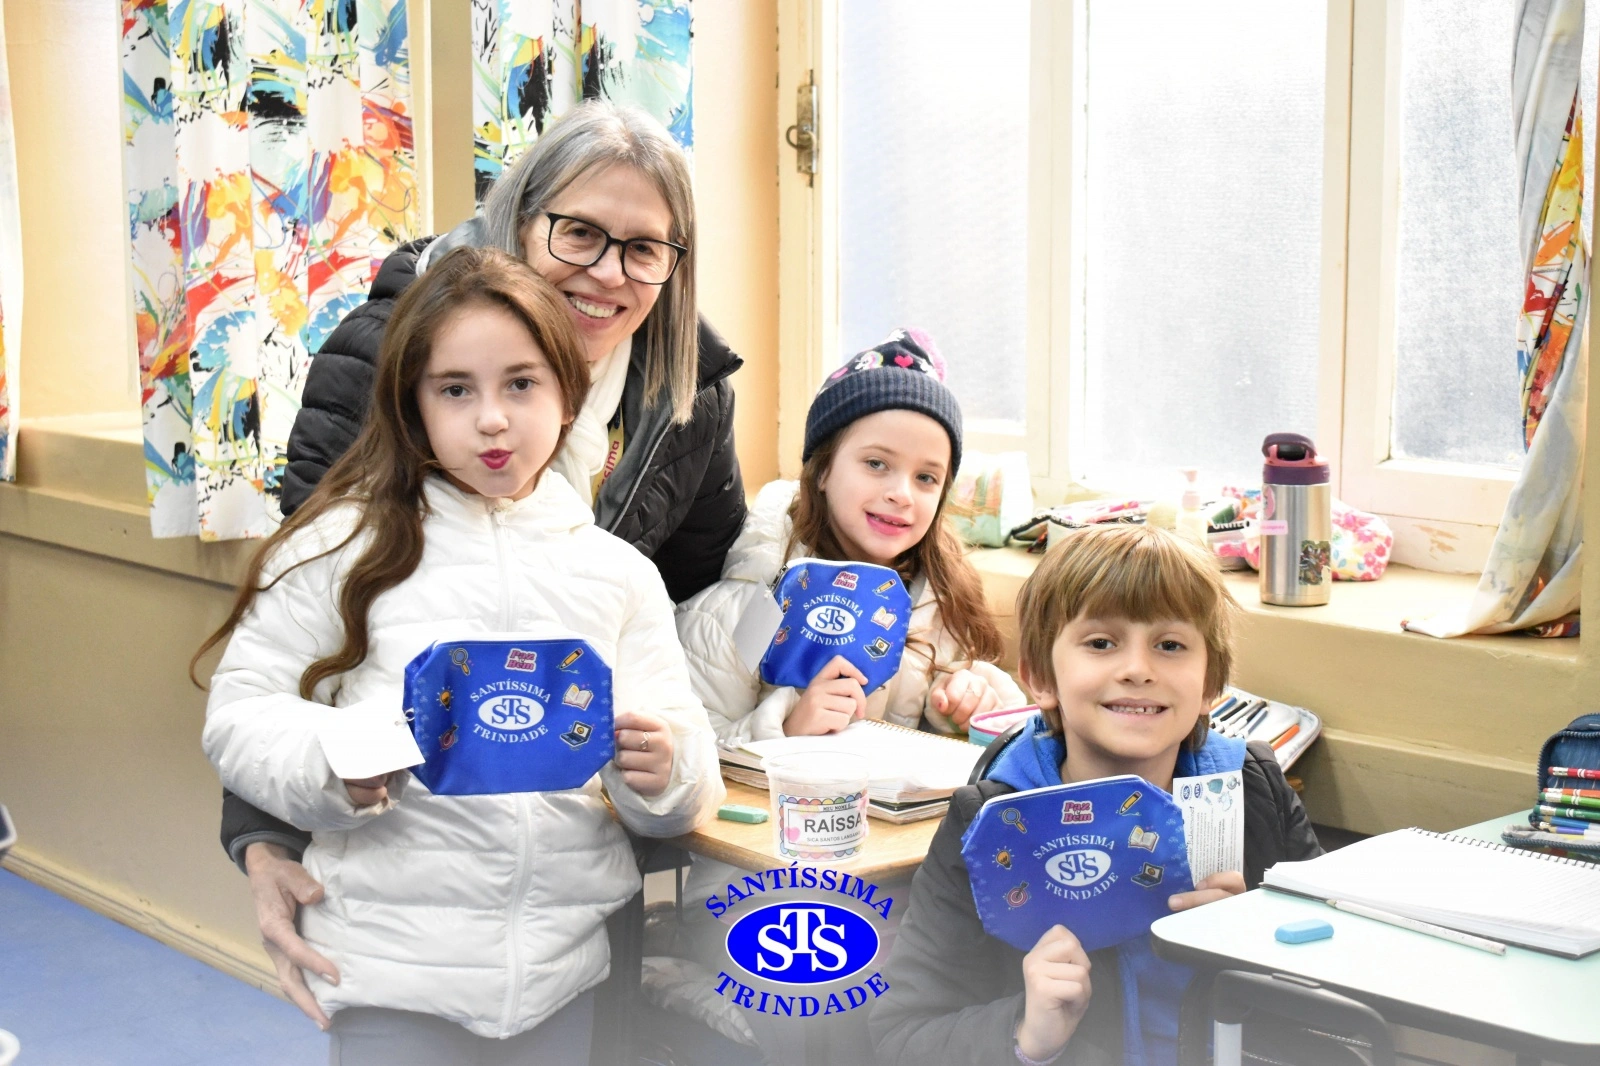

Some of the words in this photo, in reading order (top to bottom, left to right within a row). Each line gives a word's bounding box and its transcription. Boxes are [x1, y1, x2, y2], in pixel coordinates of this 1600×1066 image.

[803, 592, 864, 618] SANTÍSSIMA
[815, 608, 846, 631] STS
[800, 626, 856, 646] TRINDADE
[510, 650, 535, 660] Paz
[470, 678, 551, 703] SANTÍSSIMA
[491, 698, 531, 724] STS
[473, 723, 549, 743] TRINDADE
[1063, 813, 1092, 822] Bem
[1064, 802, 1090, 812] Paz
[804, 812, 862, 833] RAÍSSA
[1032, 833, 1115, 859] SANTÍSSIMA
[1058, 852, 1099, 881] STS
[1045, 872, 1119, 900] TRINDADE
